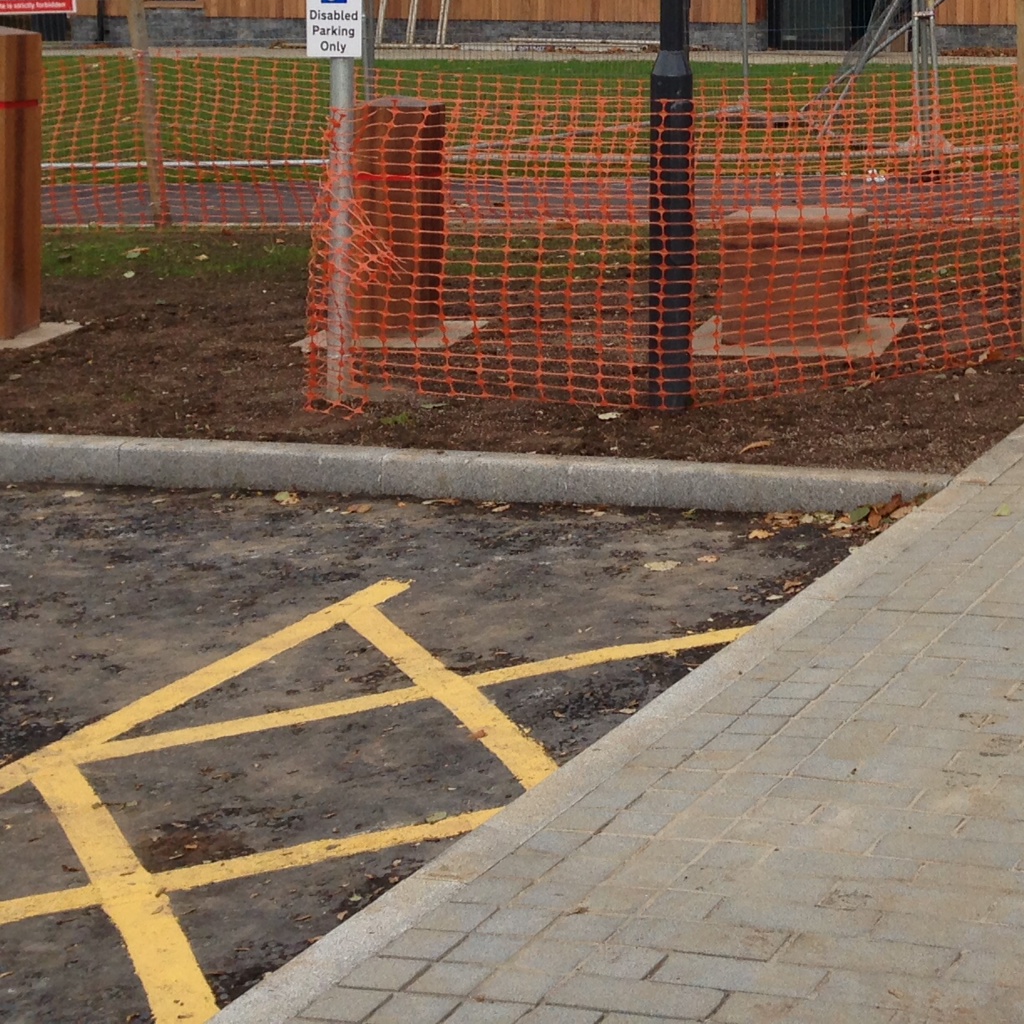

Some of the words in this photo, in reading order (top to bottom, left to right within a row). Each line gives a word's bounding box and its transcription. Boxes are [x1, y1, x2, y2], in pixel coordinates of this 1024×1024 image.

[13, 2, 35, 10] strictly
[309, 9, 358, 21] Disabled
[312, 25, 355, 38] Parking
[320, 40, 347, 53] Only
